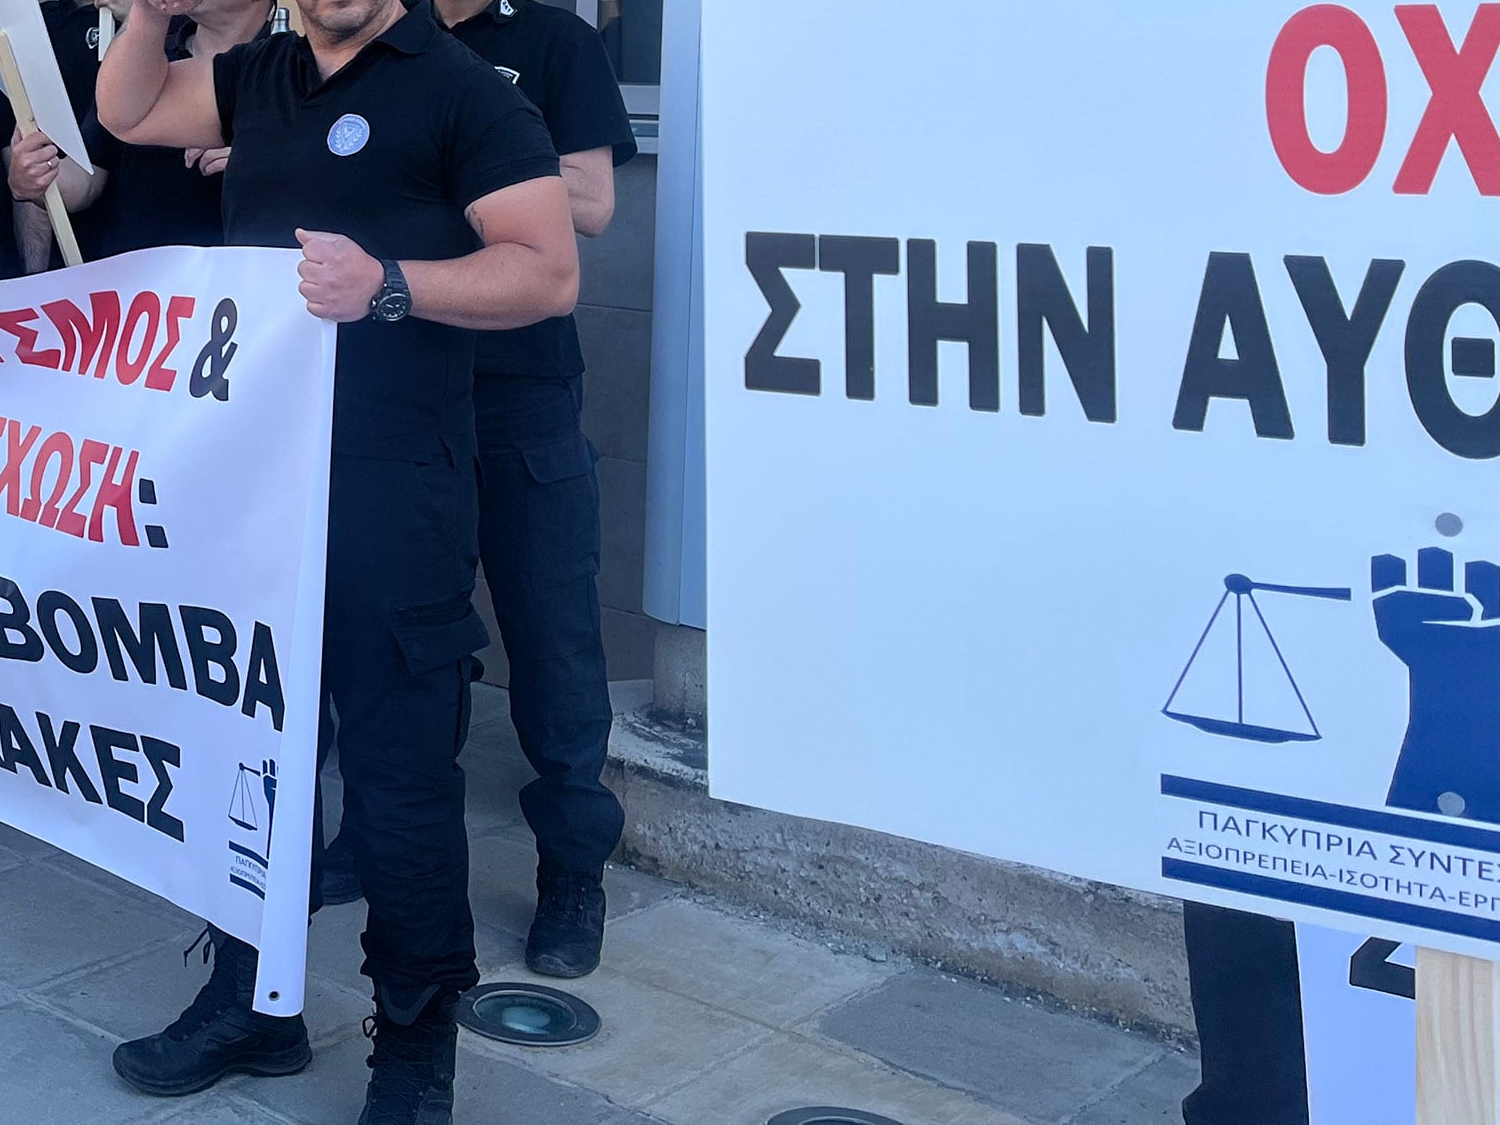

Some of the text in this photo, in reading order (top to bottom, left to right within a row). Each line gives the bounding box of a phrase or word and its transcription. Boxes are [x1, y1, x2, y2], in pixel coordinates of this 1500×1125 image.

[1265, 3, 1500, 197] ΟΧ
[190, 297, 239, 401] &
[744, 230, 1500, 460] ΣΤΗΝ ΑΥΘ
[1198, 811, 1378, 861] ΠΑΓΚΥΠΡΙΑ
